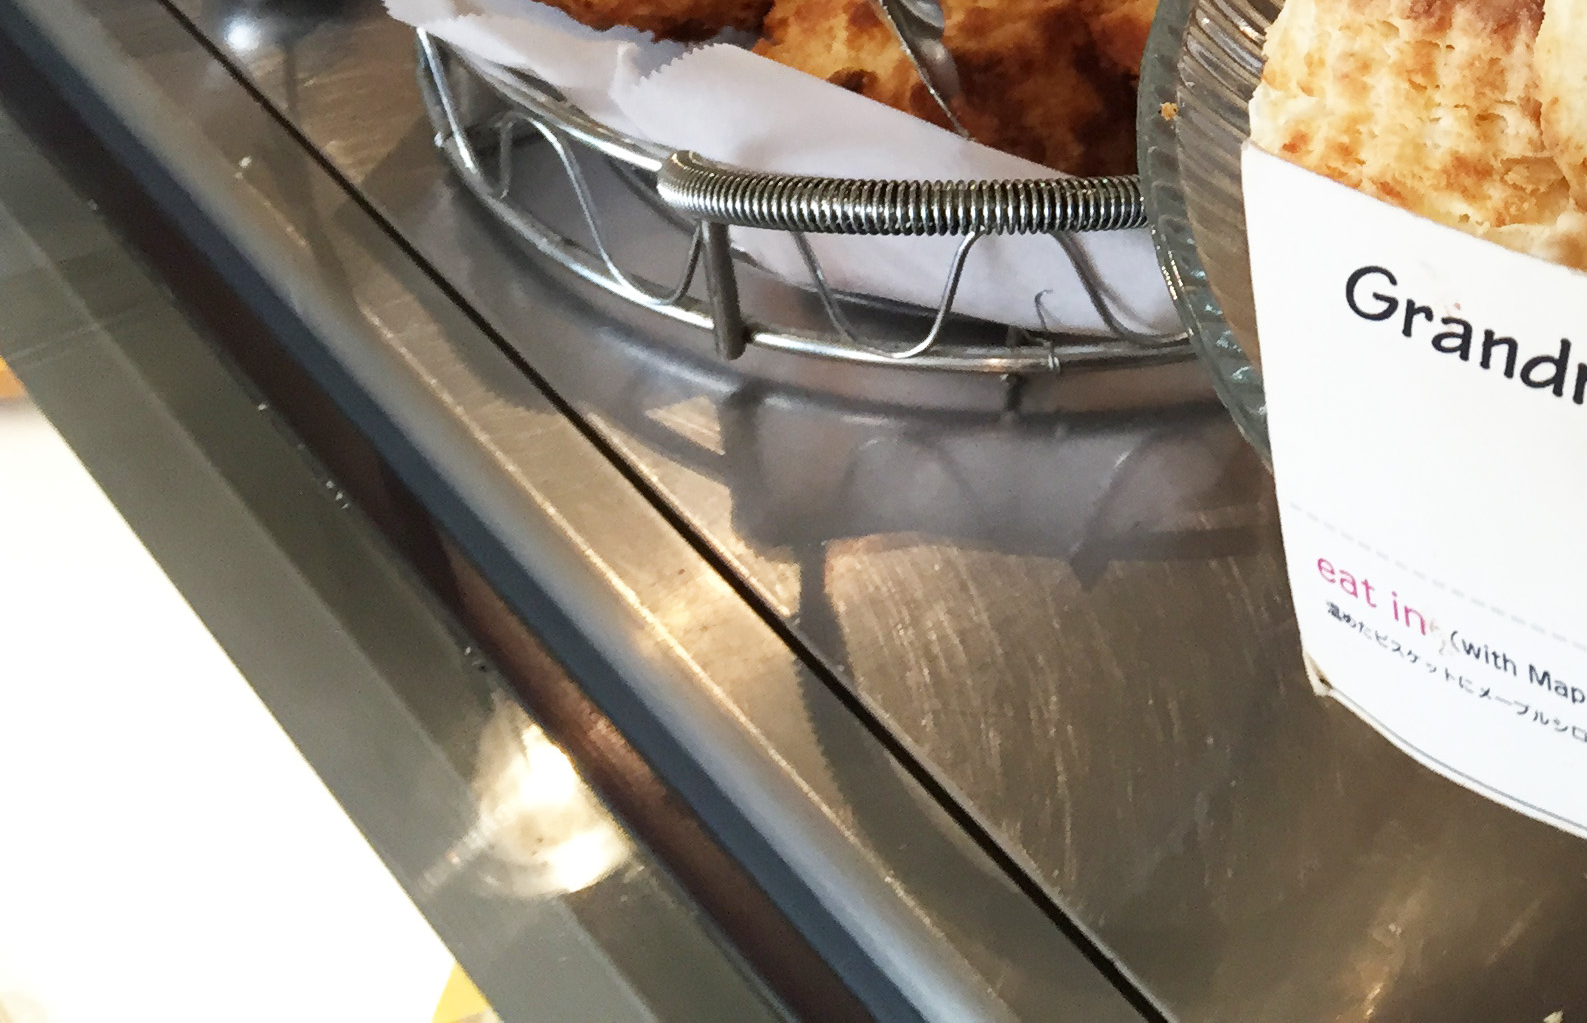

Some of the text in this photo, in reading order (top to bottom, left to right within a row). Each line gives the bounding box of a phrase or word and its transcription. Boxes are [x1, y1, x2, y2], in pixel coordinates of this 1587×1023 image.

[1317, 558, 1377, 608] eat
[1391, 591, 1426, 635] in
[1451, 631, 1517, 676] (with
